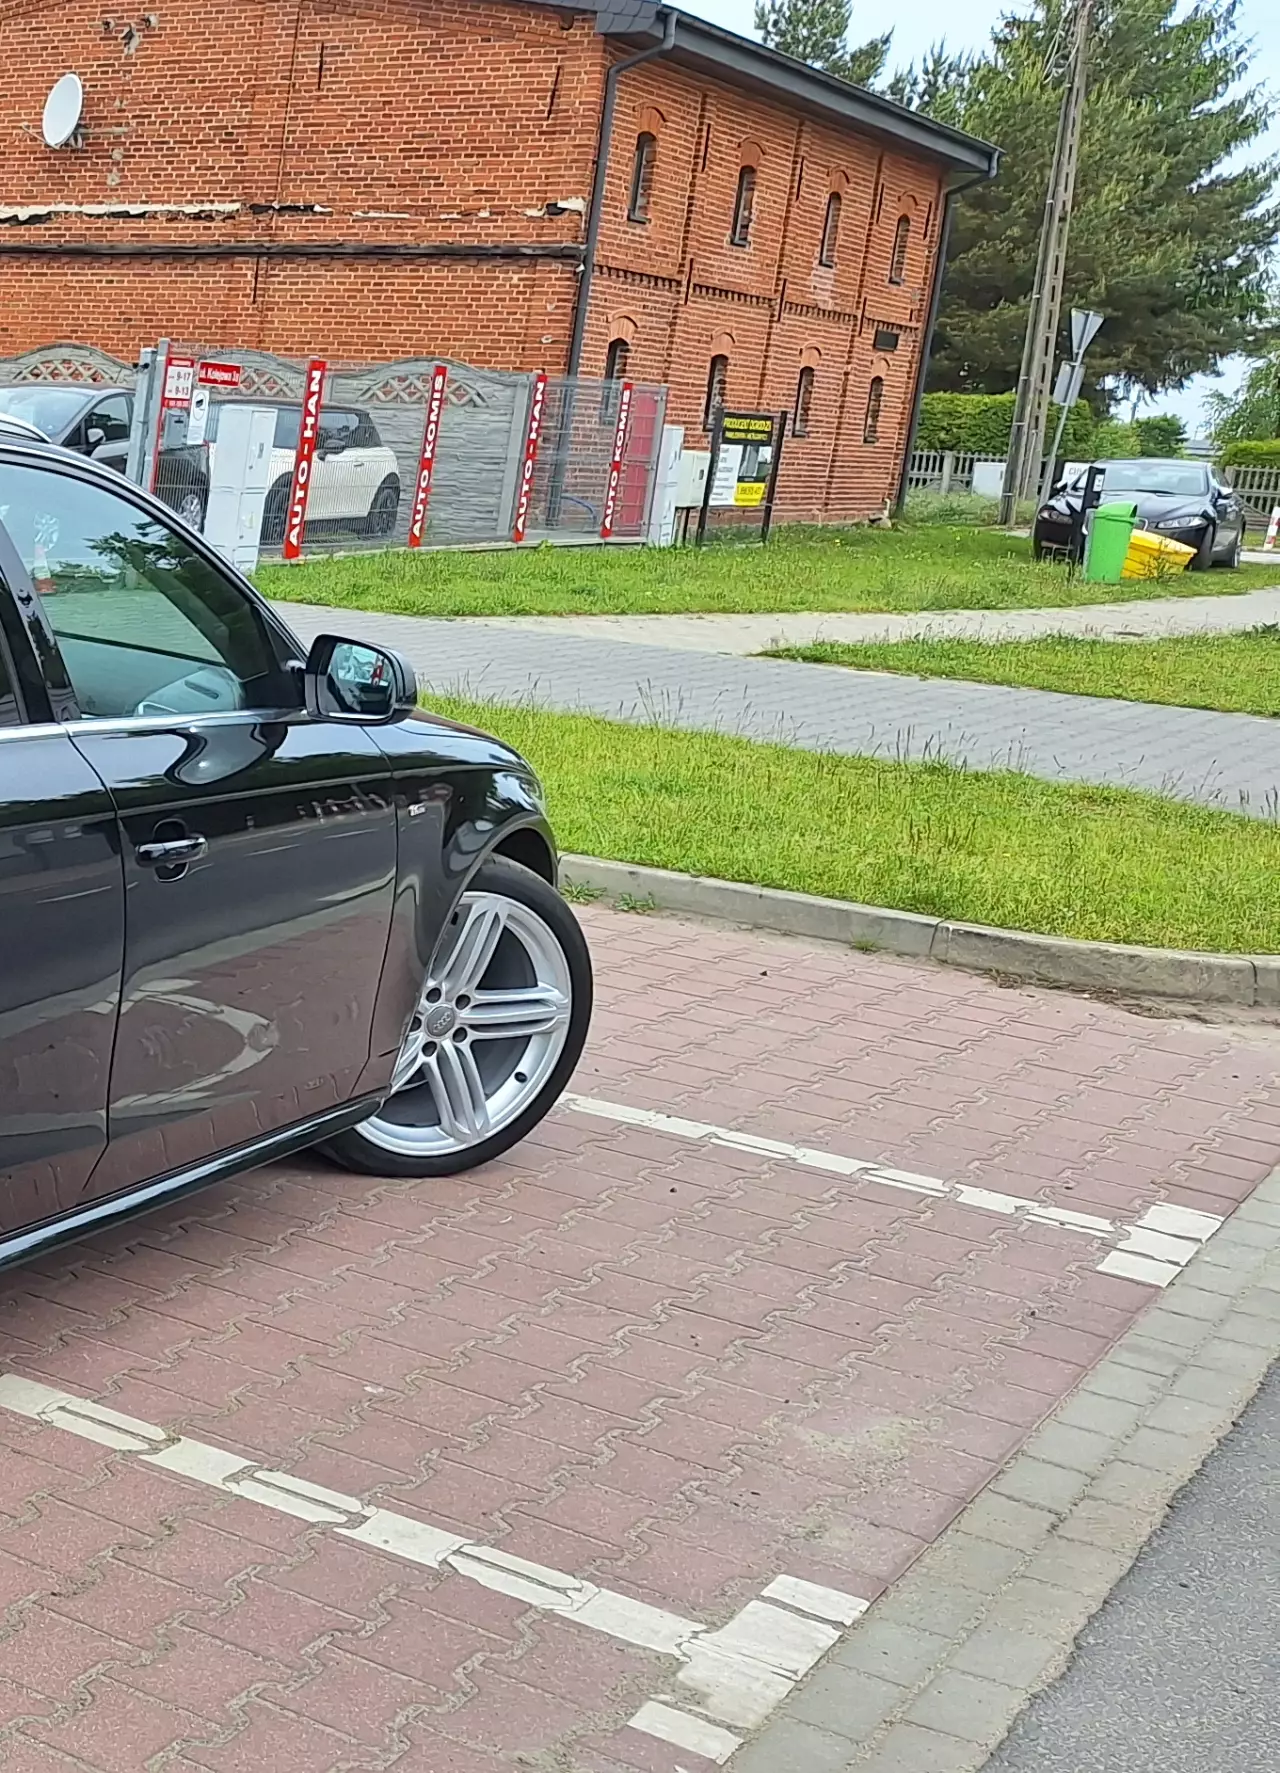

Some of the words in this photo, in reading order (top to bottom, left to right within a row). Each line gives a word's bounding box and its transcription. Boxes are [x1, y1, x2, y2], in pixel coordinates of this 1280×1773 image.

[289, 460, 308, 547] AUTO
[304, 370, 322, 438] HAN
[412, 469, 430, 537] AUTO
[424, 374, 443, 459] KOMIS
[516, 459, 532, 532] AUTO
[604, 471, 618, 529] AUTO
